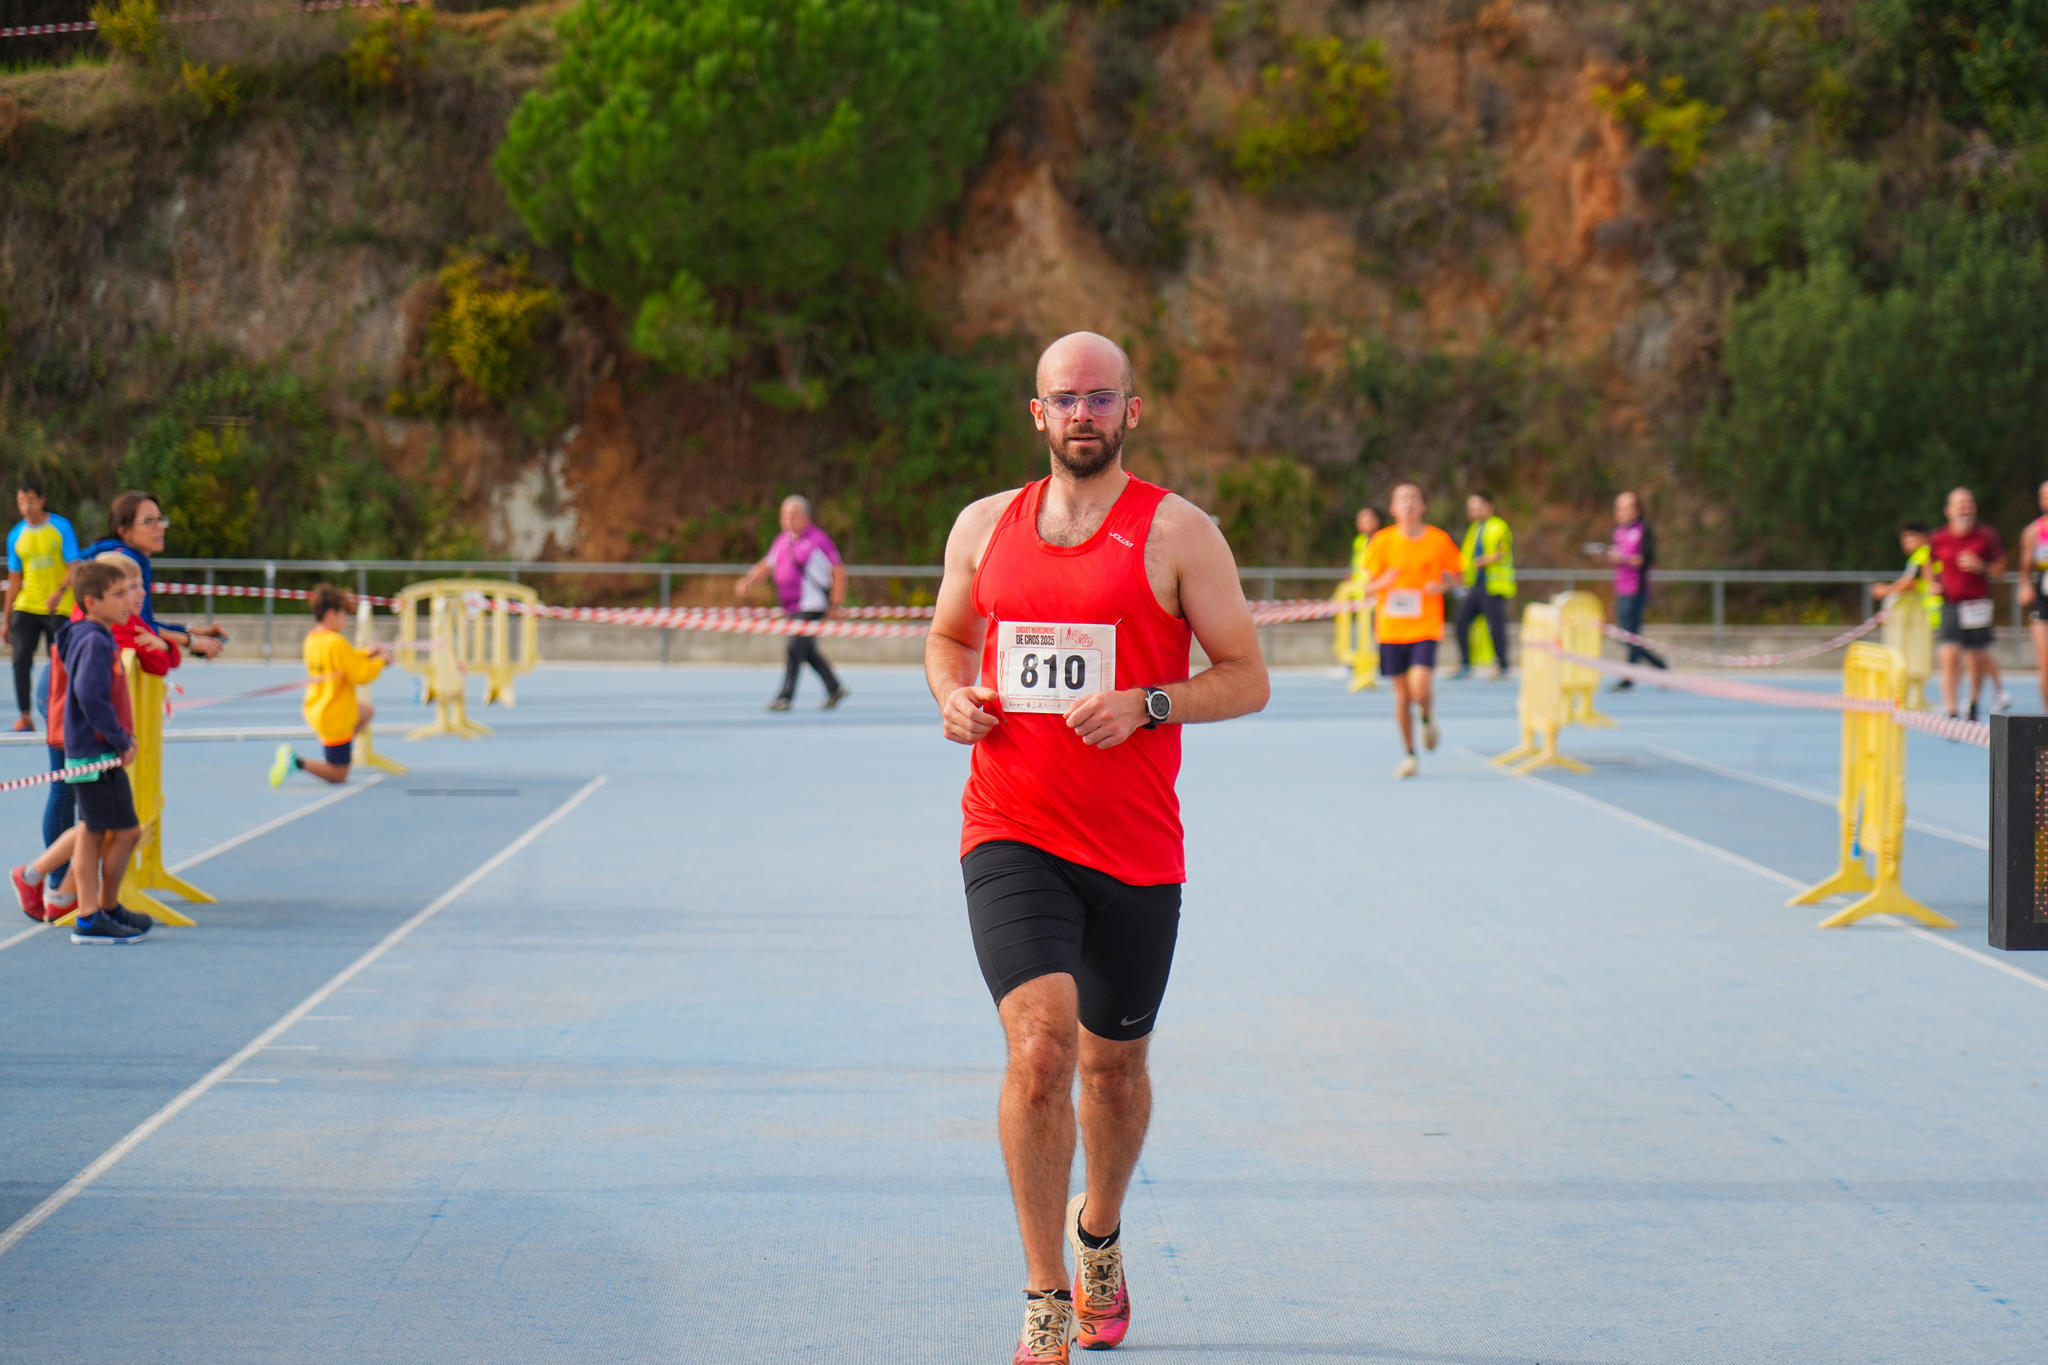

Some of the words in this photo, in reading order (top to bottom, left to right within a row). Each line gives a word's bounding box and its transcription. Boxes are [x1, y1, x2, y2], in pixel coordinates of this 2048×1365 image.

[1016, 626, 1031, 634] CIRCUIT
[1016, 635, 1024, 645] DE
[1025, 635, 1040, 645] CROS
[1040, 635, 1055, 646] 2025
[1020, 653, 1086, 690] 810
